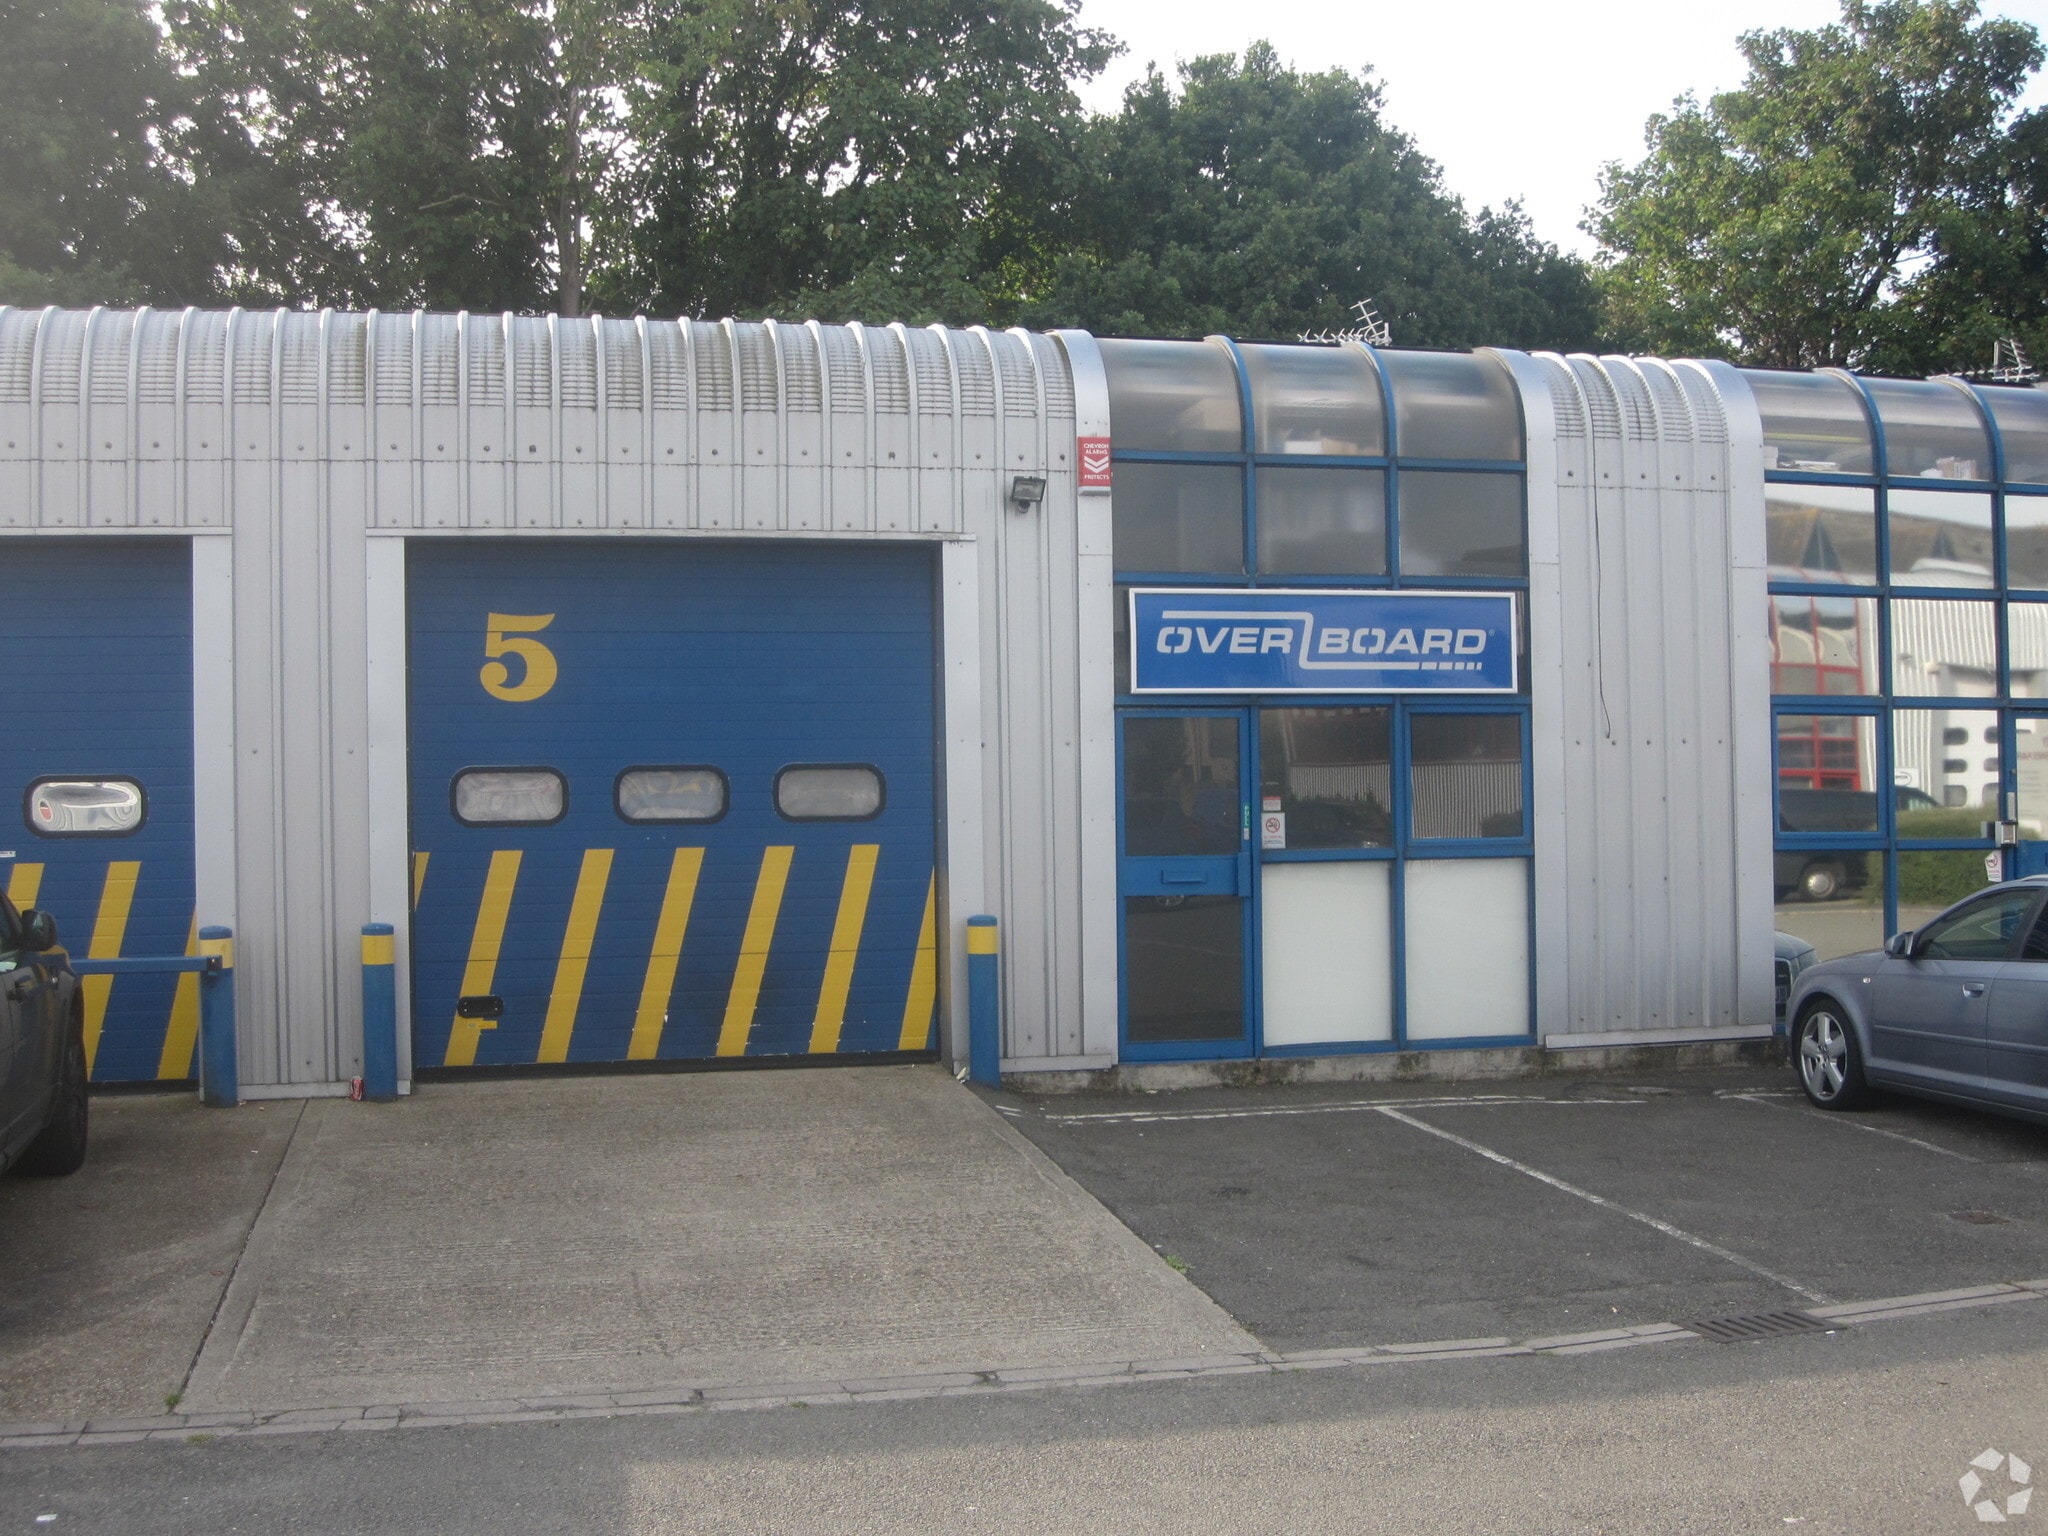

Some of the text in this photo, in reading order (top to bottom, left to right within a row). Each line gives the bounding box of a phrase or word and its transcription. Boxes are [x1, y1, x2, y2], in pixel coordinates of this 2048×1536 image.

[480, 612, 558, 702] 5
[1156, 626, 1487, 655] OVER BOARD
